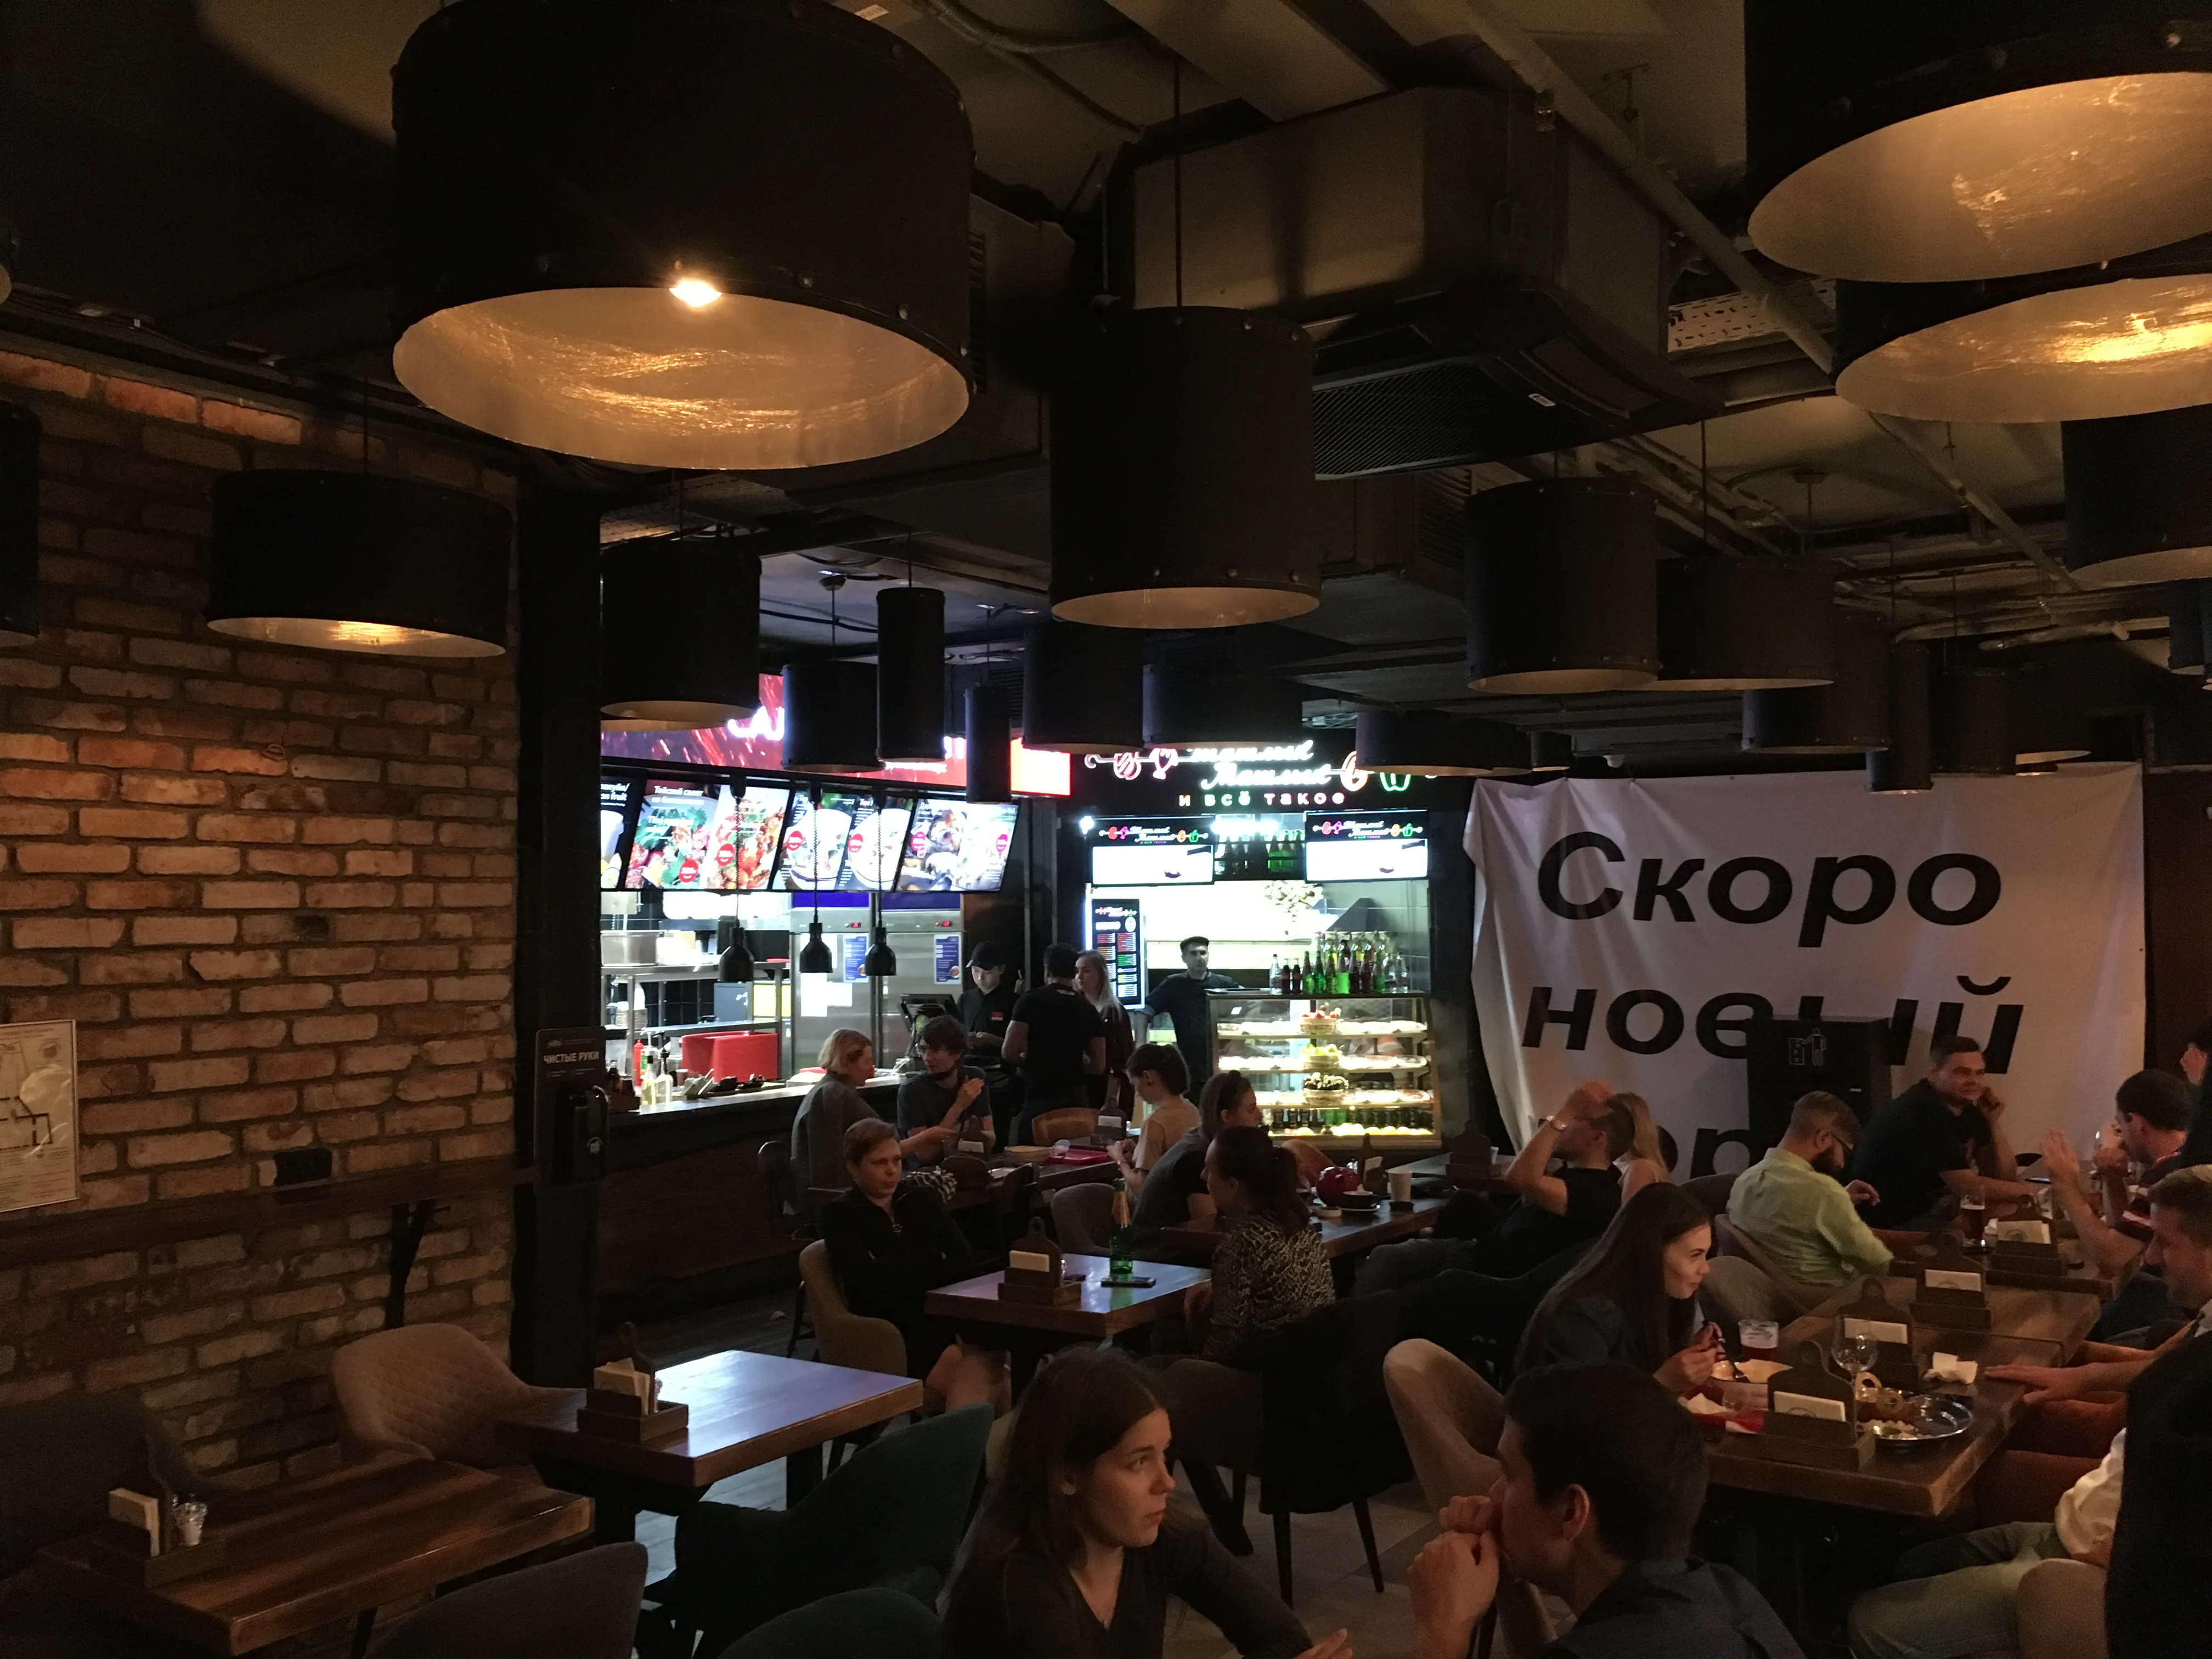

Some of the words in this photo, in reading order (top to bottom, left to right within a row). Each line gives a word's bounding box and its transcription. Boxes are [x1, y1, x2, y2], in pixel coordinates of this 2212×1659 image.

[1179, 795, 1191, 806] и
[1204, 791, 1251, 806] всё
[1264, 792, 1345, 805] такое
[1537, 831, 2002, 948] Скоро
[544, 1053, 577, 1064] ЧИСТЫЕ
[578, 1051, 600, 1062] РУКИ
